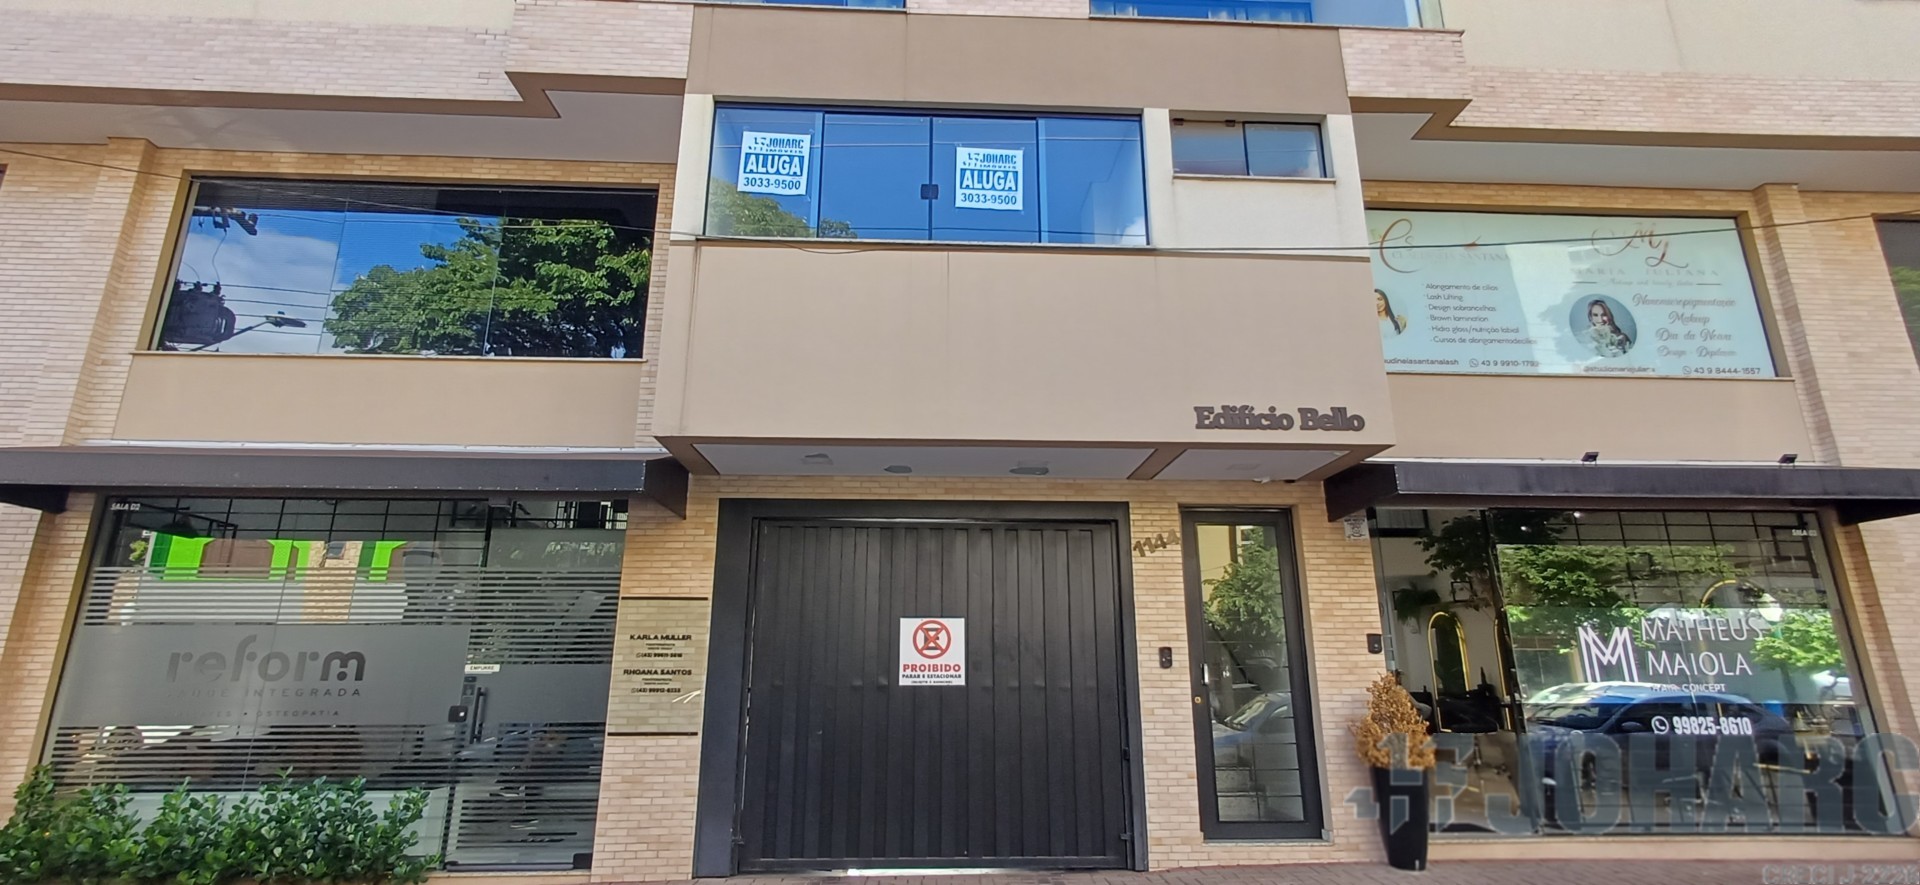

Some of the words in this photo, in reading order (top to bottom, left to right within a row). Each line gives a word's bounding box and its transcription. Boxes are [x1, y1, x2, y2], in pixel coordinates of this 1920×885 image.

[766, 137, 804, 149] JOHARC
[980, 153, 1017, 164] JOHARC
[745, 154, 801, 176] ALUGA
[743, 177, 801, 190] 3033-9500
[961, 170, 1016, 191] ALUGA
[961, 193, 1017, 205] 3033-9500
[1425, 283, 1471, 292] Alongamento
[1428, 303, 1452, 312] Design
[1452, 304, 1497, 312] sobrancelhas
[1453, 314, 1489, 322] lamination
[1683, 330, 1696, 341] da
[1481, 359, 1491, 367] 43
[1193, 405, 1294, 430] Edifício
[1297, 406, 1366, 432] Bello
[110, 502, 129, 511] SALA
[1132, 528, 1181, 557] 1144
[1641, 616, 1764, 641] MATHEUS
[166, 633, 366, 683] reform
[1647, 650, 1753, 676] MAIOLA
[903, 663, 961, 673] PROIBIDO
[243, 688, 362, 698] INTEGRADA
[1681, 684, 1726, 692] CONCEPT
[255, 710, 341, 718] OSTEOPATIA
[1672, 716, 1753, 735] 99825-8610
